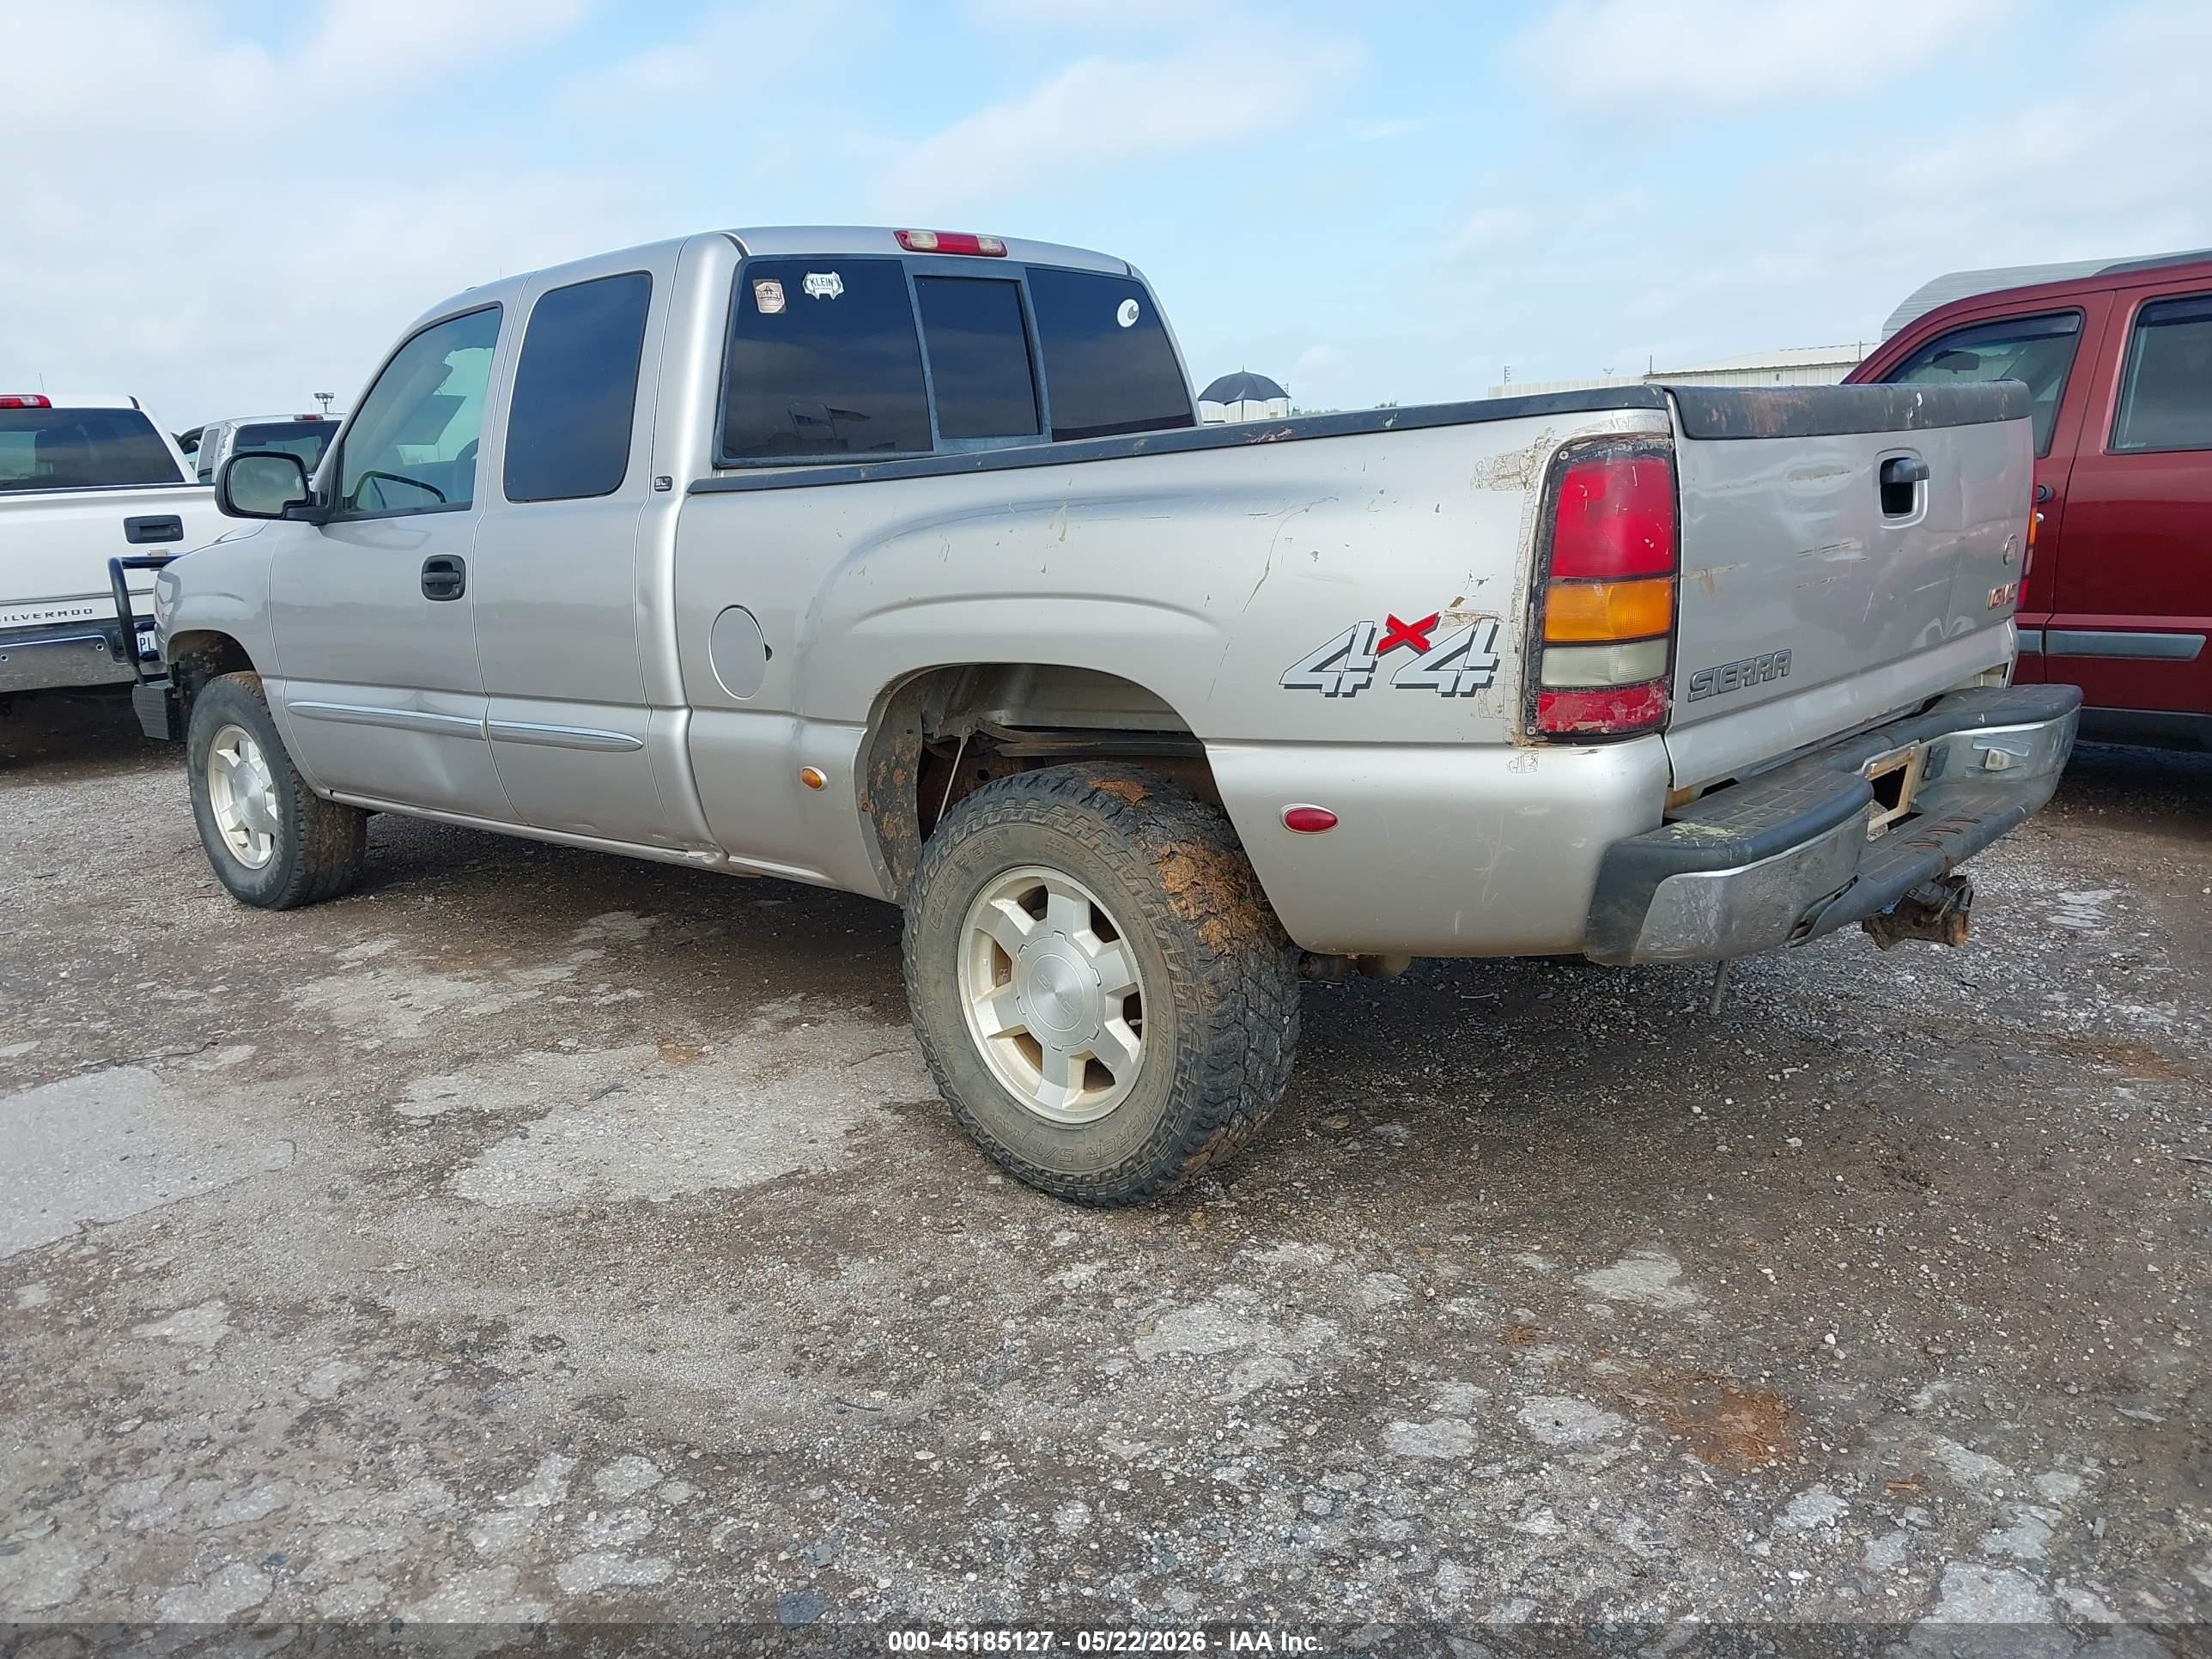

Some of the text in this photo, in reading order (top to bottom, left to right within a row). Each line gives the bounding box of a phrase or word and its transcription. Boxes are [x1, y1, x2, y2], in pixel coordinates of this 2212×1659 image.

[810, 276, 834, 289] KLEIN
[1687, 648, 1792, 702] SIERRA
[929, 836, 1002, 930] COOPER
[1085, 1009, 1169, 1162] DISCOVERER
[1031, 1146, 1075, 1163] S/T
